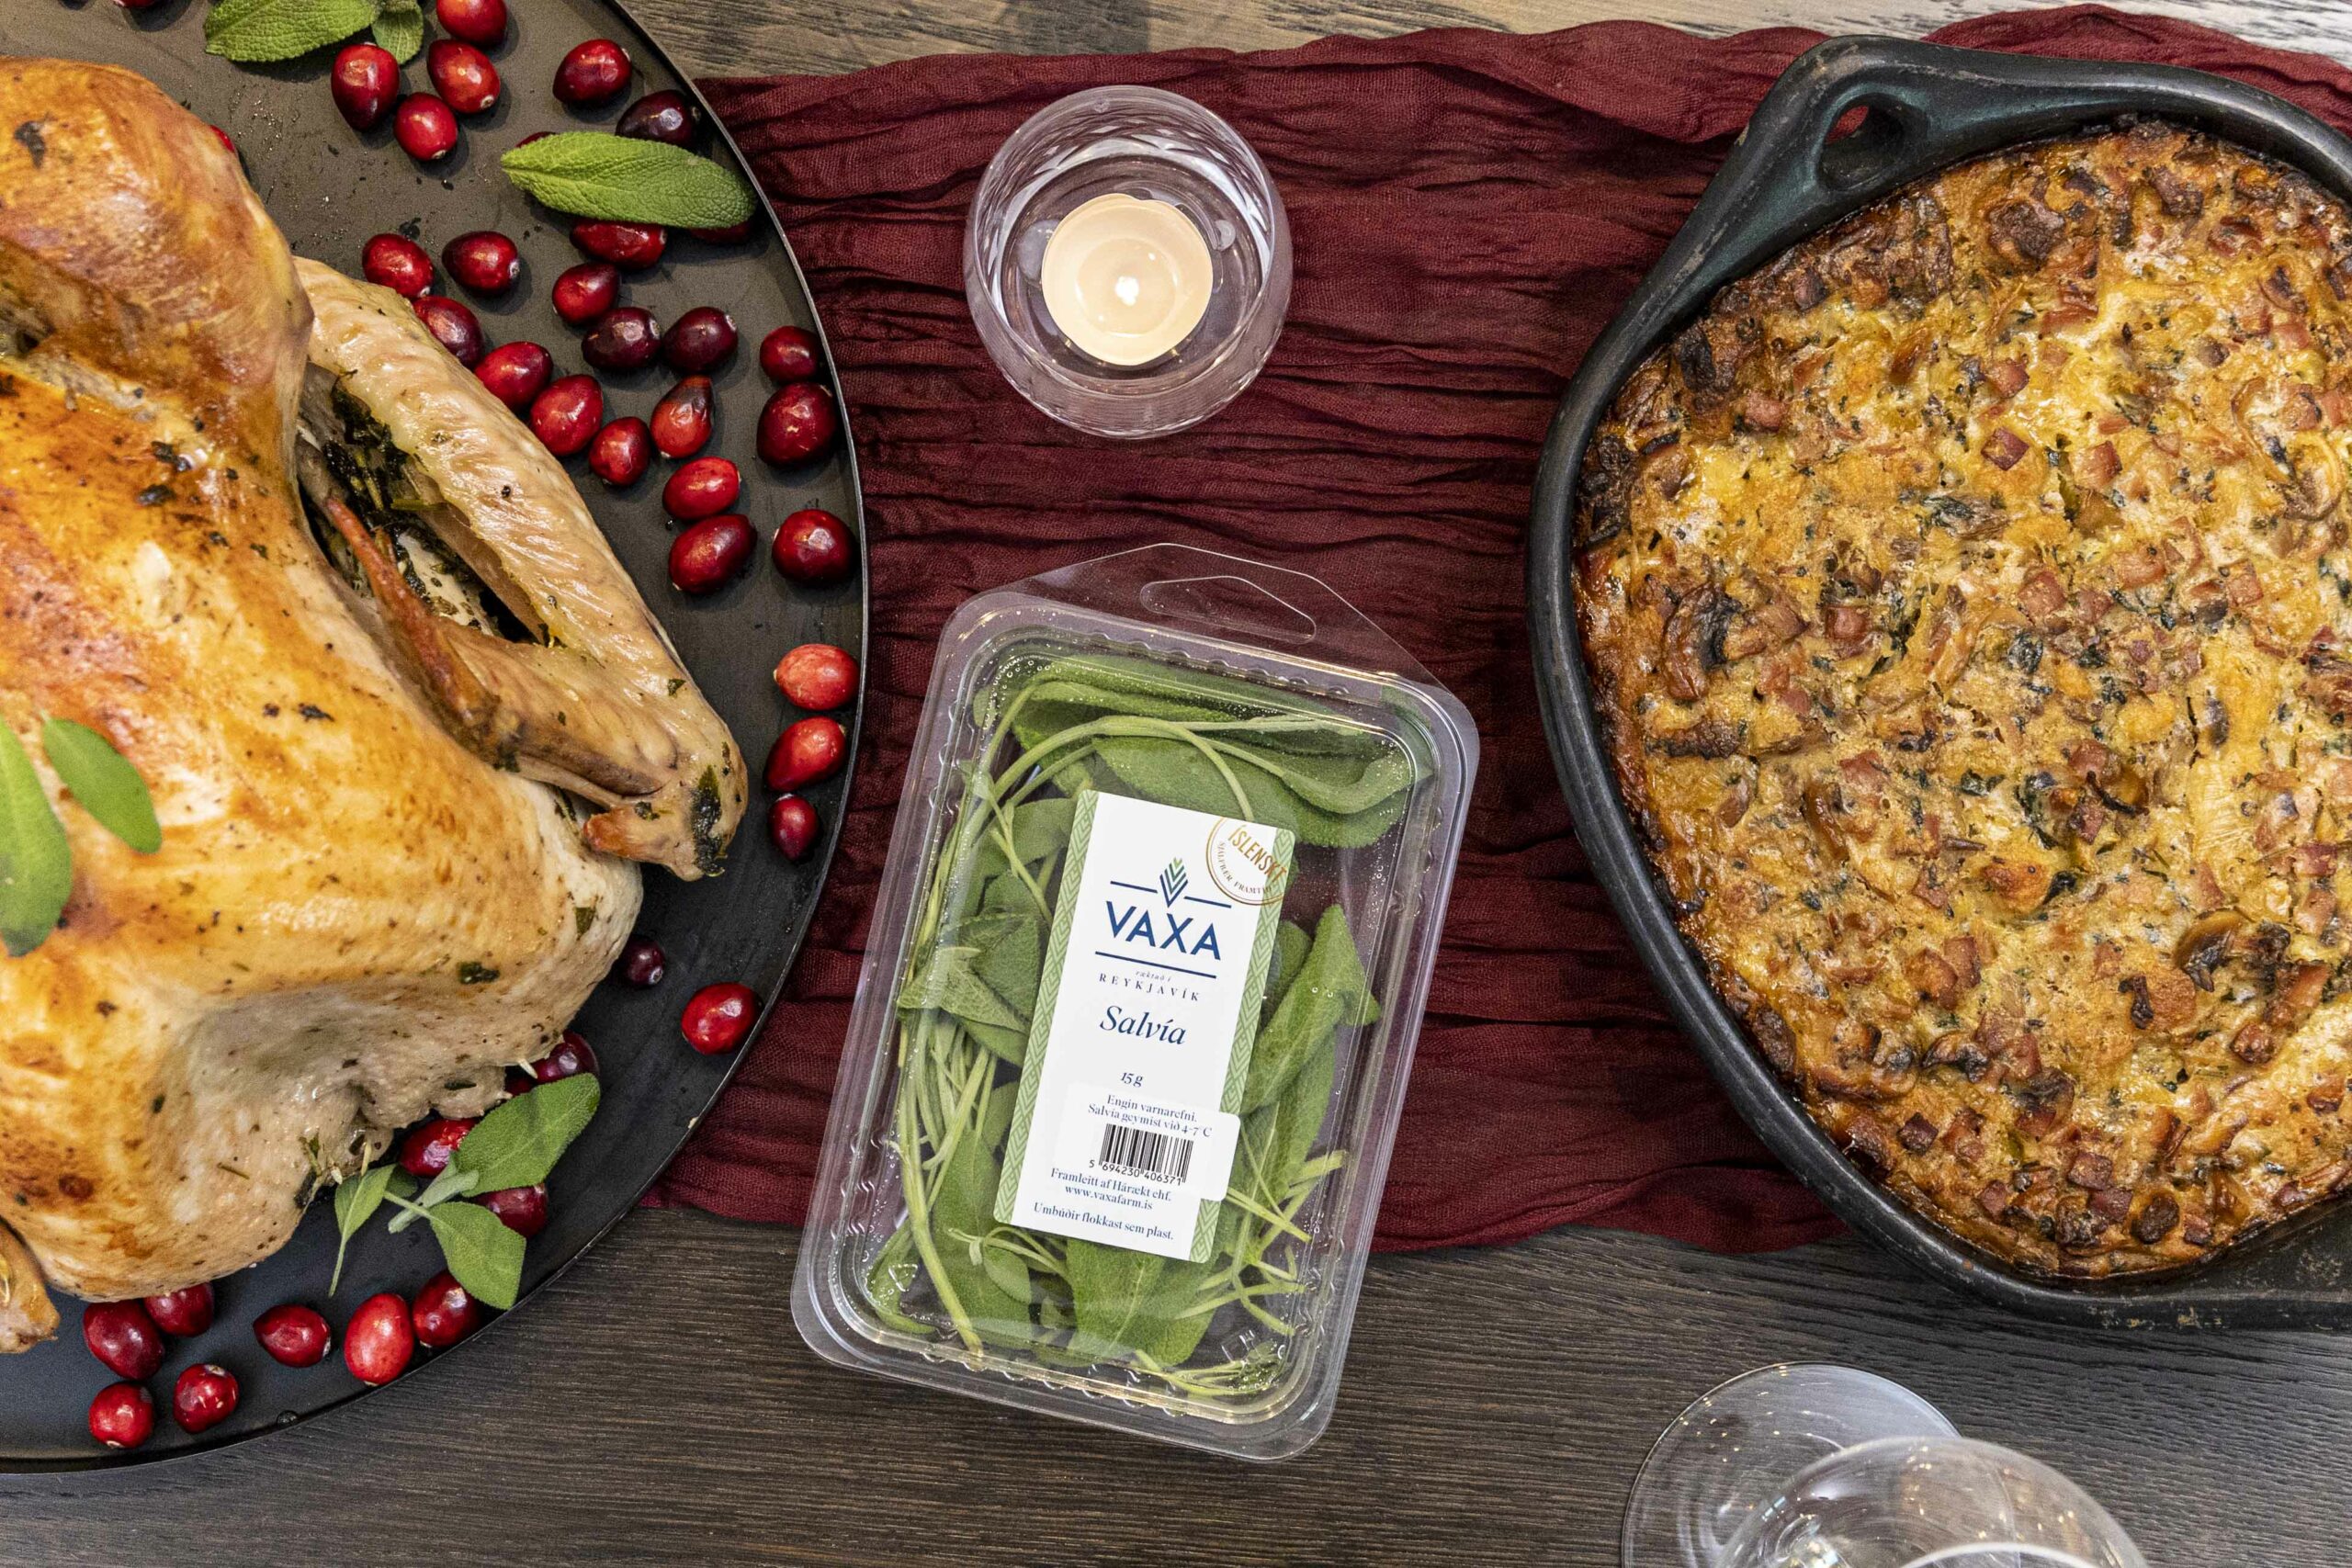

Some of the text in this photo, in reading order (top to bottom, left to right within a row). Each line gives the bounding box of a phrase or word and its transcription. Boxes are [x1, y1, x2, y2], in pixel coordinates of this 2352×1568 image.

[1228, 825, 1287, 884] ÍSLENSKT
[1106, 900, 1221, 961] VAXA
[1099, 973, 1200, 1001] REYKJAVÍK
[1100, 1006, 1186, 1044] Salvía
[1121, 1072, 1143, 1087] 15 g
[1088, 1104, 1120, 1120] Salvía
[1120, 1111, 1161, 1127] geymist
[1164, 1119, 1180, 1130] við
[1107, 1095, 1197, 1122] Engin varnarefni.
[1050, 1168, 1172, 1201] Framleitt af Hárækt ehf.
[1102, 1161, 1139, 1178] 694230
[1144, 1170, 1182, 1186] 406371
[1065, 1185, 1153, 1211] www.vaxafarm.is
[1034, 1202, 1173, 1240] Umbúðir flokkast sem plast.
